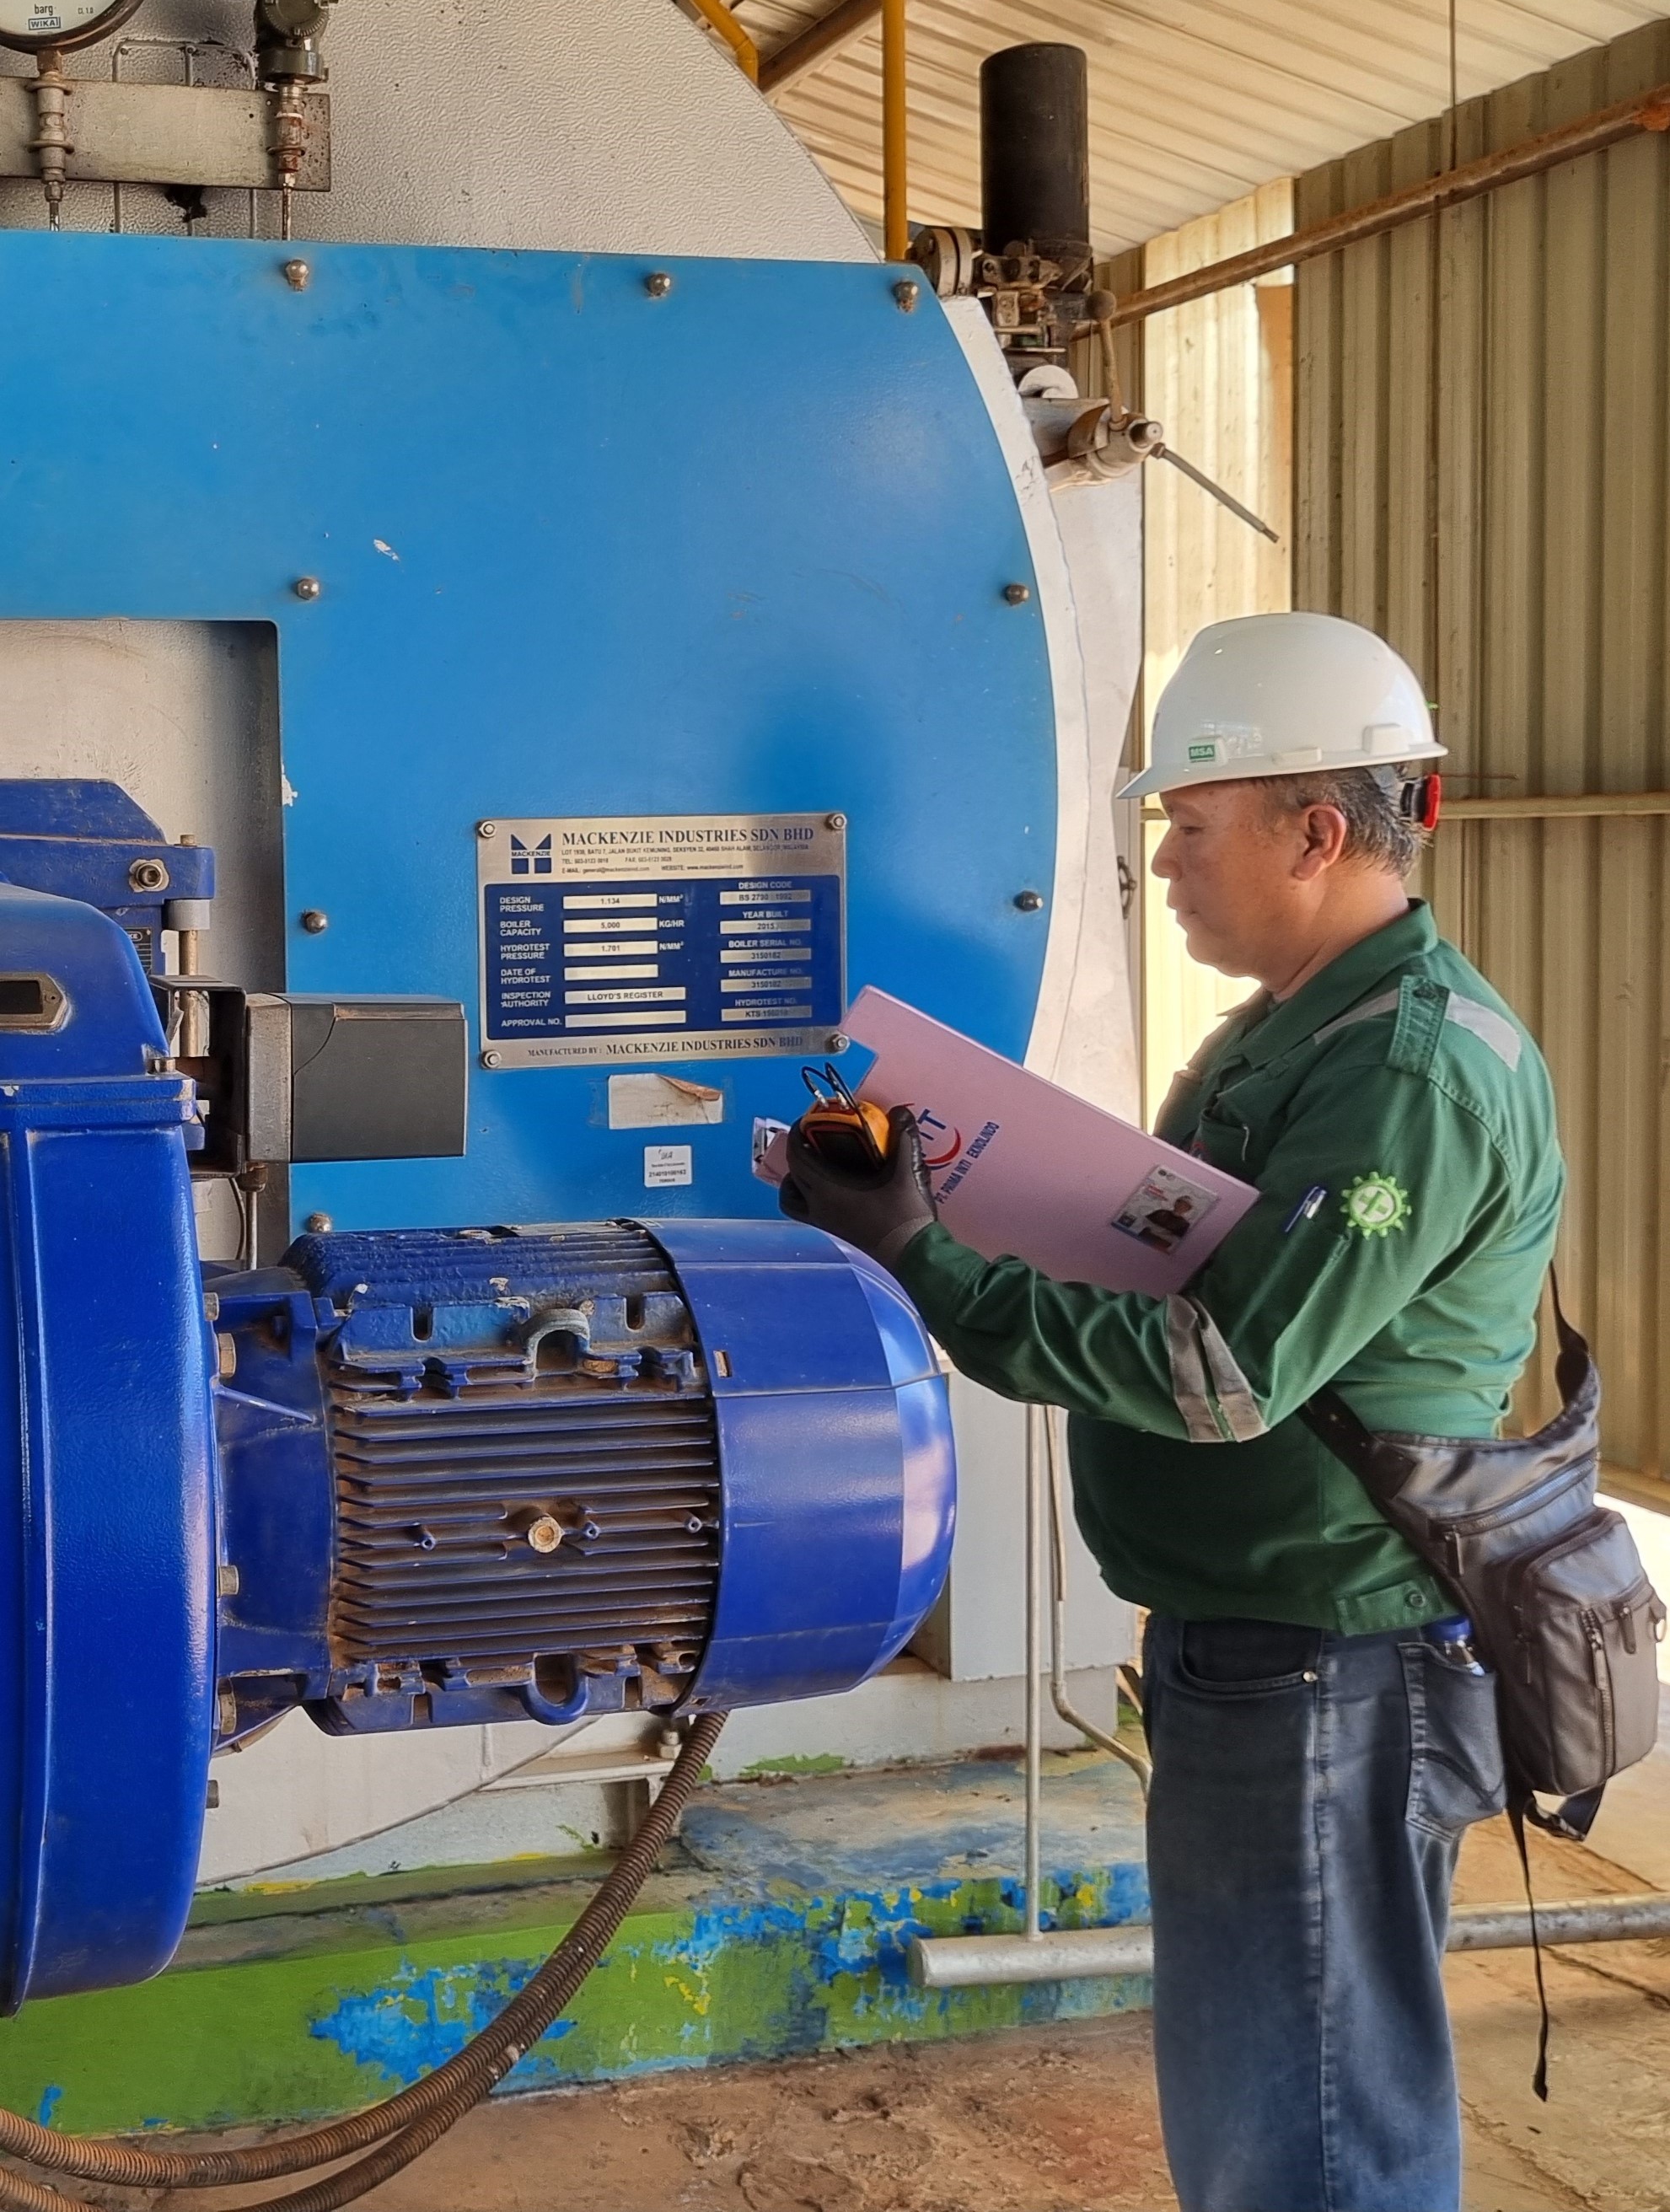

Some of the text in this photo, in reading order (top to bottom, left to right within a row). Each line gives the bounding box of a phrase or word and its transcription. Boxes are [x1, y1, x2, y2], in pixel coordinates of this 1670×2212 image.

[35, 3, 53, 16] barg
[1190, 747, 1214, 757] MSA
[561, 827, 814, 846] MACKENZIE INDUSTRIES SDN BHD
[738, 880, 792, 889] DESIGN CODE
[499, 896, 531, 905] DESIGN
[499, 904, 545, 912] PRESSURE
[742, 910, 765, 919] YEAR
[500, 920, 531, 928] BOILER
[658, 920, 685, 928] KG/HR
[500, 928, 542, 937] CAPACITY
[500, 943, 550, 953] HYDROTEST
[728, 940, 758, 948] BOILER
[760, 939, 787, 948] SERIAL
[501, 952, 545, 960] PRESSURE
[501, 968, 536, 977] DATE OF
[728, 969, 787, 977] MANUFACTURE
[501, 975, 551, 985] HYDROTEST
[501, 991, 551, 1000] INSPECTION
[587, 991, 663, 1001] LLOYD'S REGISTER
[501, 999, 549, 1008] AUTHORITY
[734, 997, 781, 1007] HYDROTEST
[501, 1017, 562, 1028] APPROVAL NO.
[528, 1047, 588, 1057] MANUFACTURED
[606, 1041, 679, 1055] MACKENZIE
[681, 1038, 751, 1053] INDUSTRIES
[753, 1037, 776, 1049] SDN
[779, 1036, 803, 1048] BHD
[940, 1173, 964, 1195] PRIMA
[954, 1159, 973, 1176] INTI
